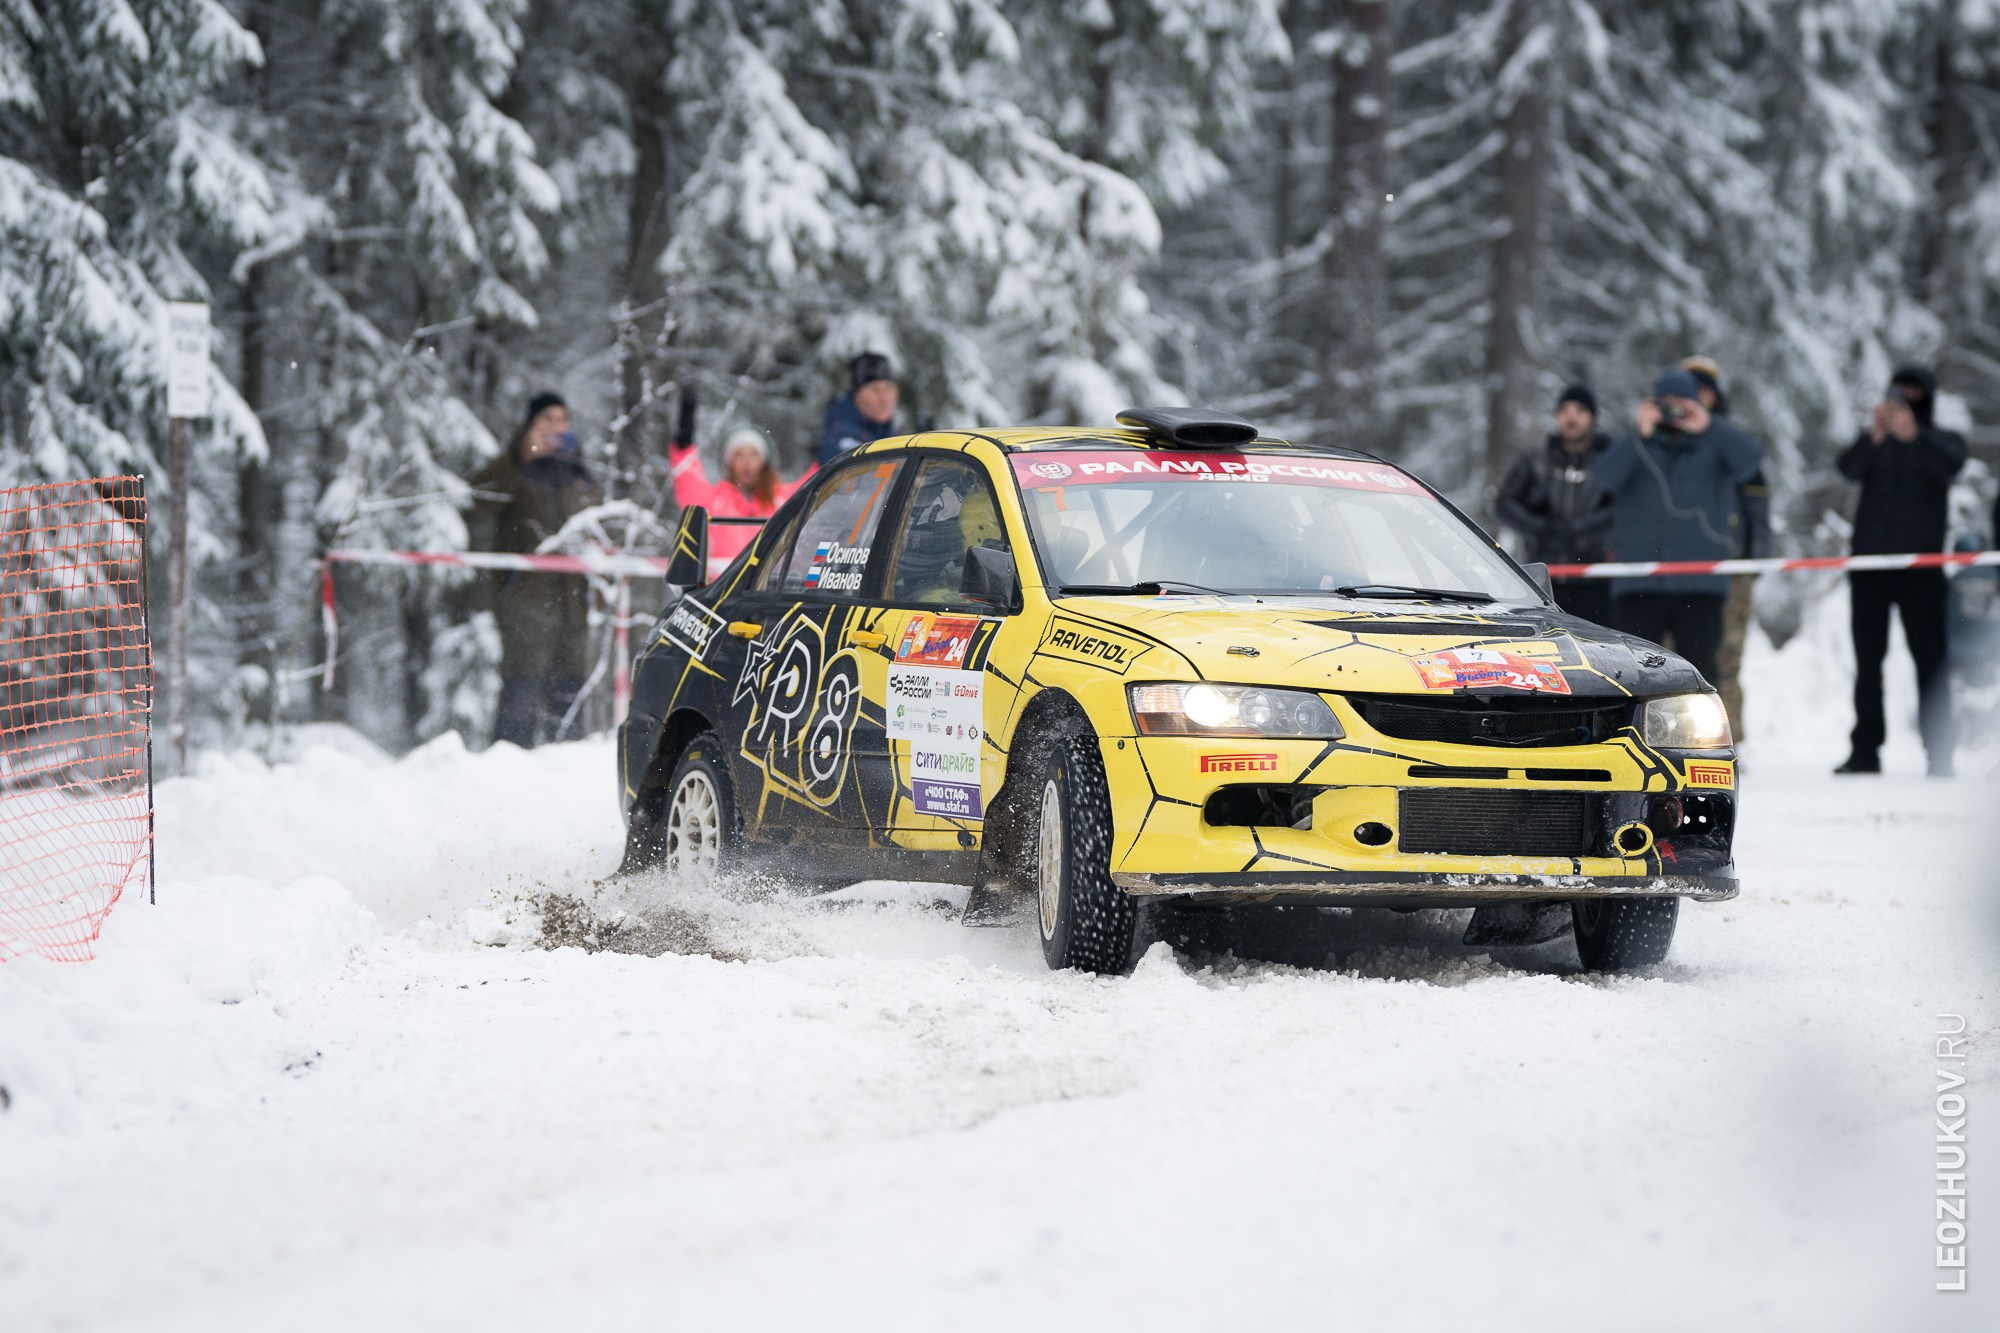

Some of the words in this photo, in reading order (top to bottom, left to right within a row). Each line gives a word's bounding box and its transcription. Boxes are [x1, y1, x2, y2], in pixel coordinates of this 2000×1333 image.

[1079, 460, 1212, 475] РАЛЛИ
[1219, 461, 1367, 483] РОССИИ
[848, 463, 897, 544] 7
[1037, 487, 1067, 511] 7
[826, 541, 871, 565] Осипов
[818, 566, 863, 590] Иванов
[670, 606, 711, 647] RAVENOL
[944, 637, 968, 662] 24
[969, 622, 997, 670] 7
[1049, 628, 1127, 665] RAVENOL
[1470, 651, 1483, 661] 7
[904, 675, 930, 687] РАЛЛИ
[1456, 669, 1508, 683] Выборг
[1507, 672, 1543, 688] 24
[902, 686, 932, 699] РОССИИ
[916, 751, 975, 773] СИТИДРАЙВ
[1200, 753, 1278, 773] PIRELLI
[1690, 765, 1732, 786] PIRELLI
[926, 800, 970, 814] www.staf.ru
